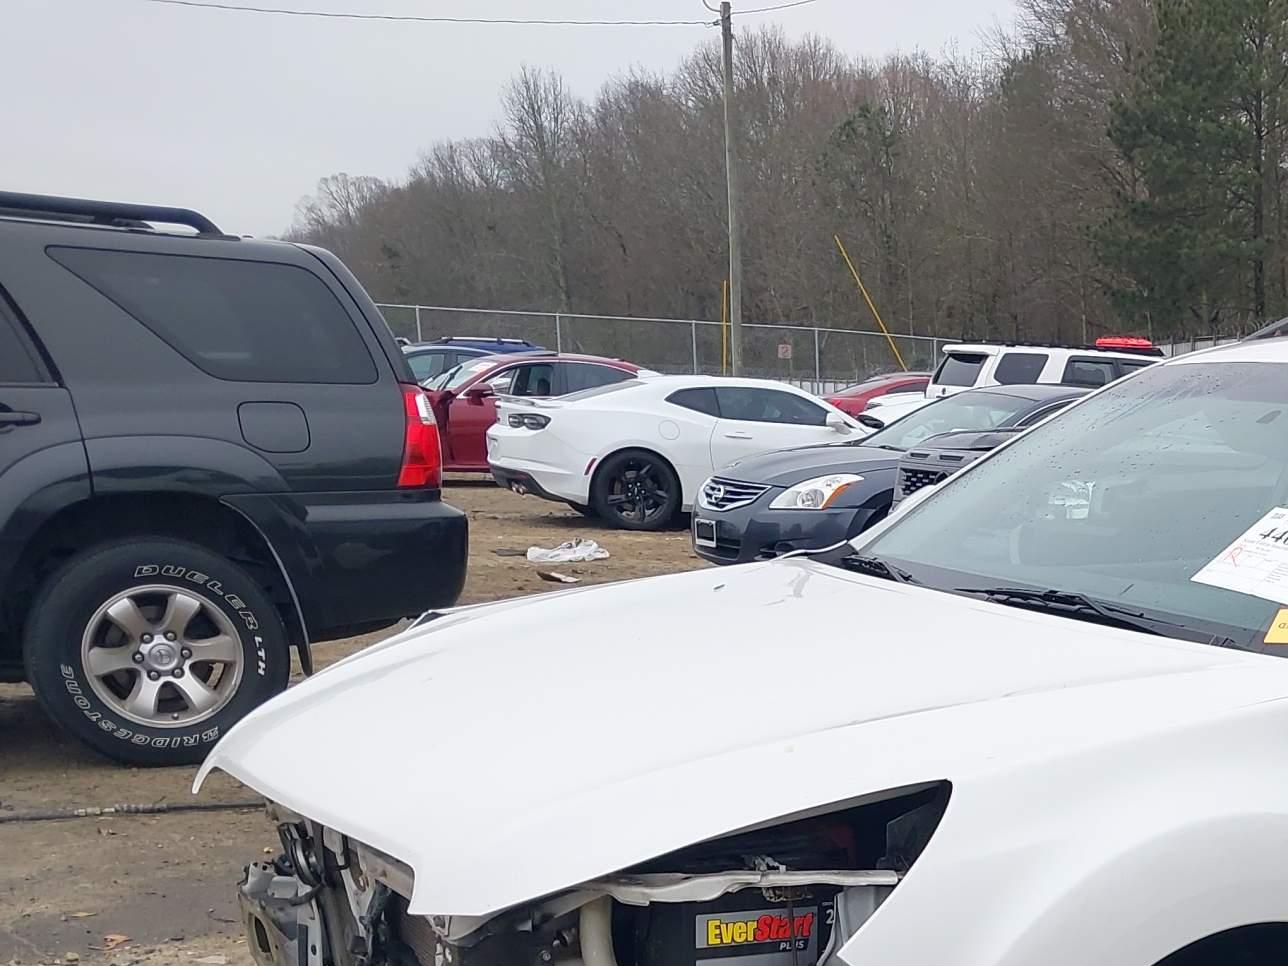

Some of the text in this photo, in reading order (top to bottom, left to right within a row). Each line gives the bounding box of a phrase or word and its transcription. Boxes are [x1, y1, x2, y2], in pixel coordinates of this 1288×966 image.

[134, 564, 266, 677] DUELER LTH
[60, 663, 220, 749] BRIDGESTONE
[706, 912, 814, 946] EverStart
